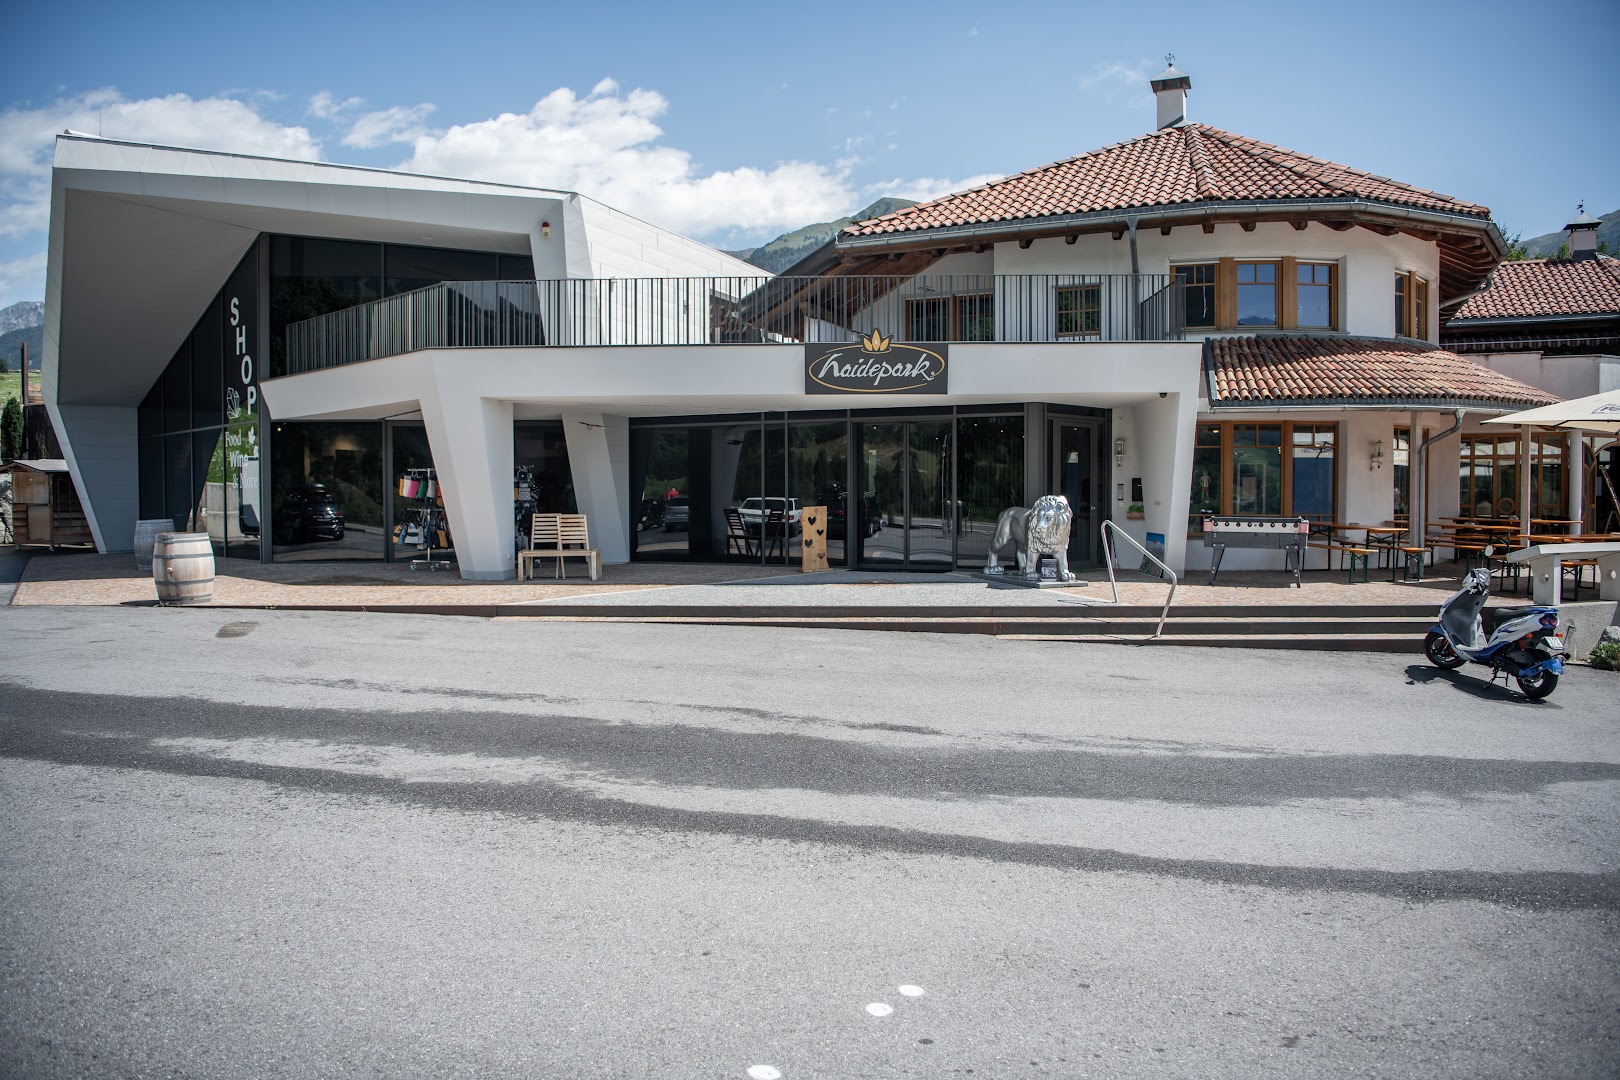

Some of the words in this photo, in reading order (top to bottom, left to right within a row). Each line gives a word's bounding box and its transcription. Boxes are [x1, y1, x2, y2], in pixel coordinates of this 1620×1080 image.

[230, 297, 257, 415] SHOP
[225, 429, 241, 447] Food
[230, 451, 248, 467] Wine
[233, 473, 239, 489] &
[240, 473, 258, 489] More
